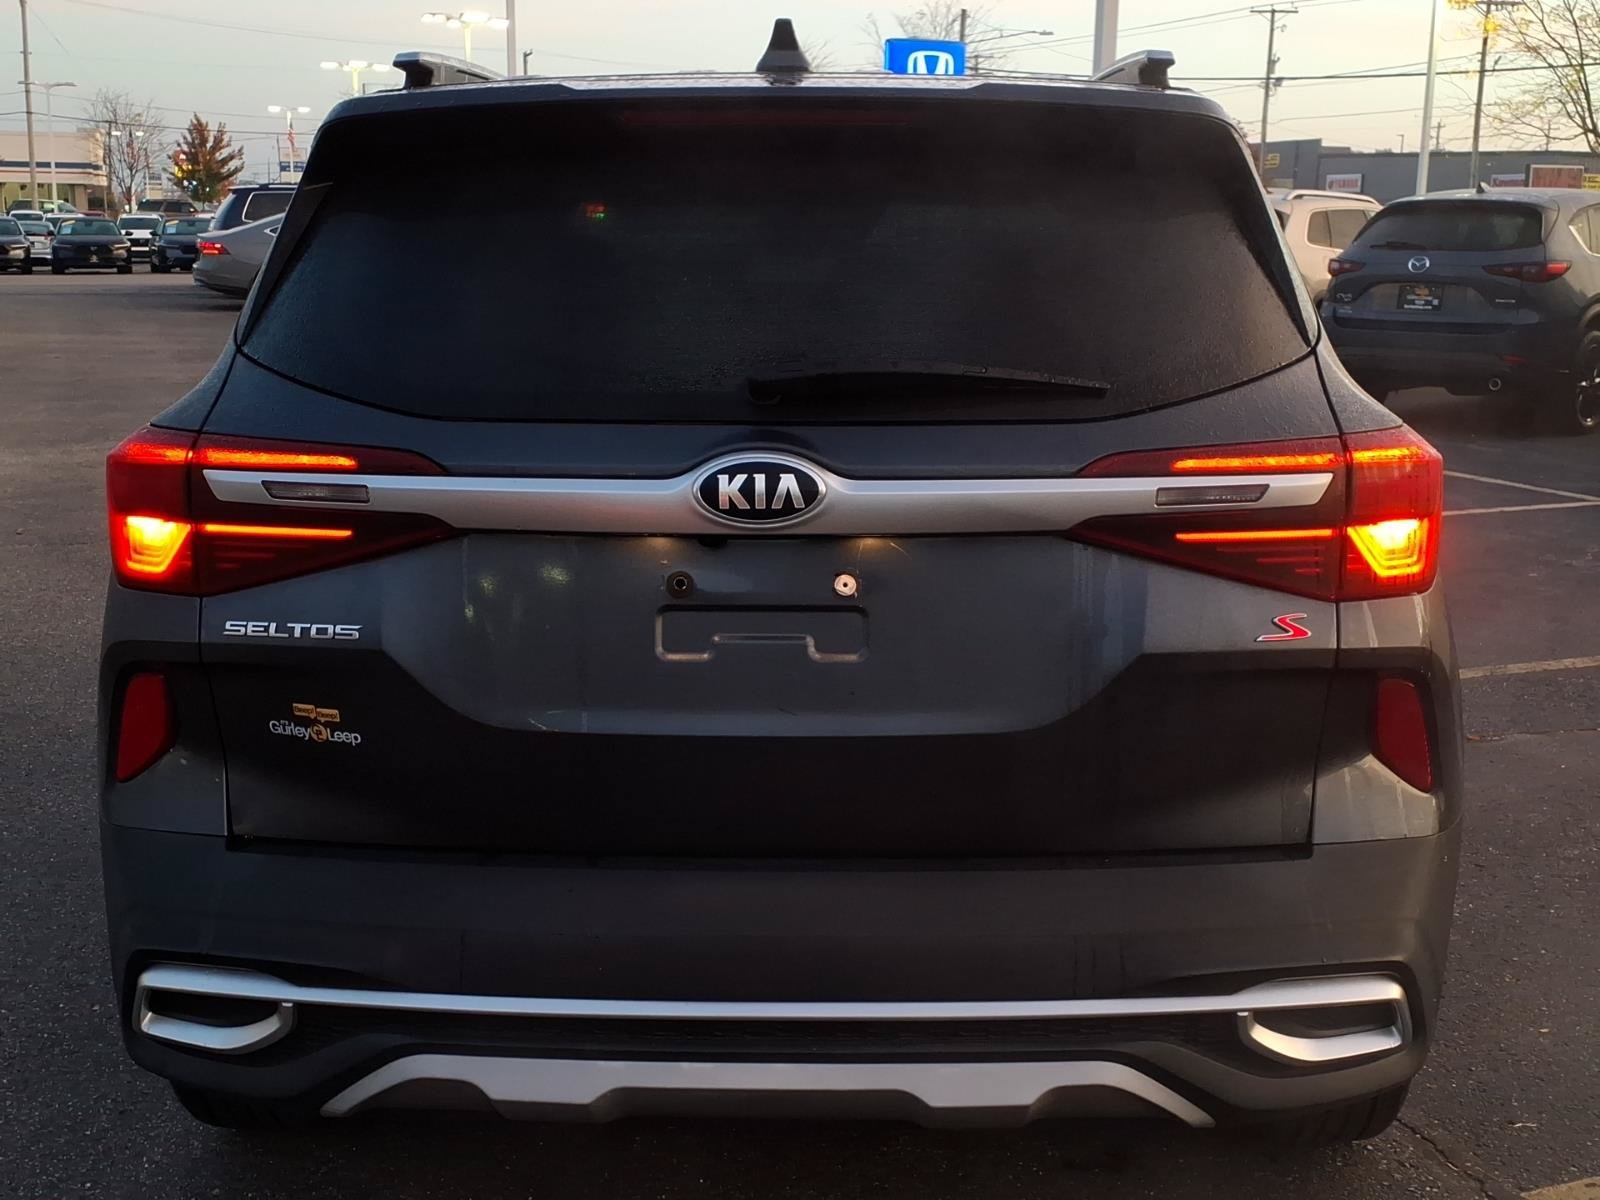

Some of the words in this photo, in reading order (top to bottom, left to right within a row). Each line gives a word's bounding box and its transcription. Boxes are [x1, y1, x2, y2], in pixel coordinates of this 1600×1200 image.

[717, 473, 805, 510] KIA
[222, 620, 363, 640] SELTOS
[1255, 612, 1312, 642] S
[327, 728, 361, 746] Leep
